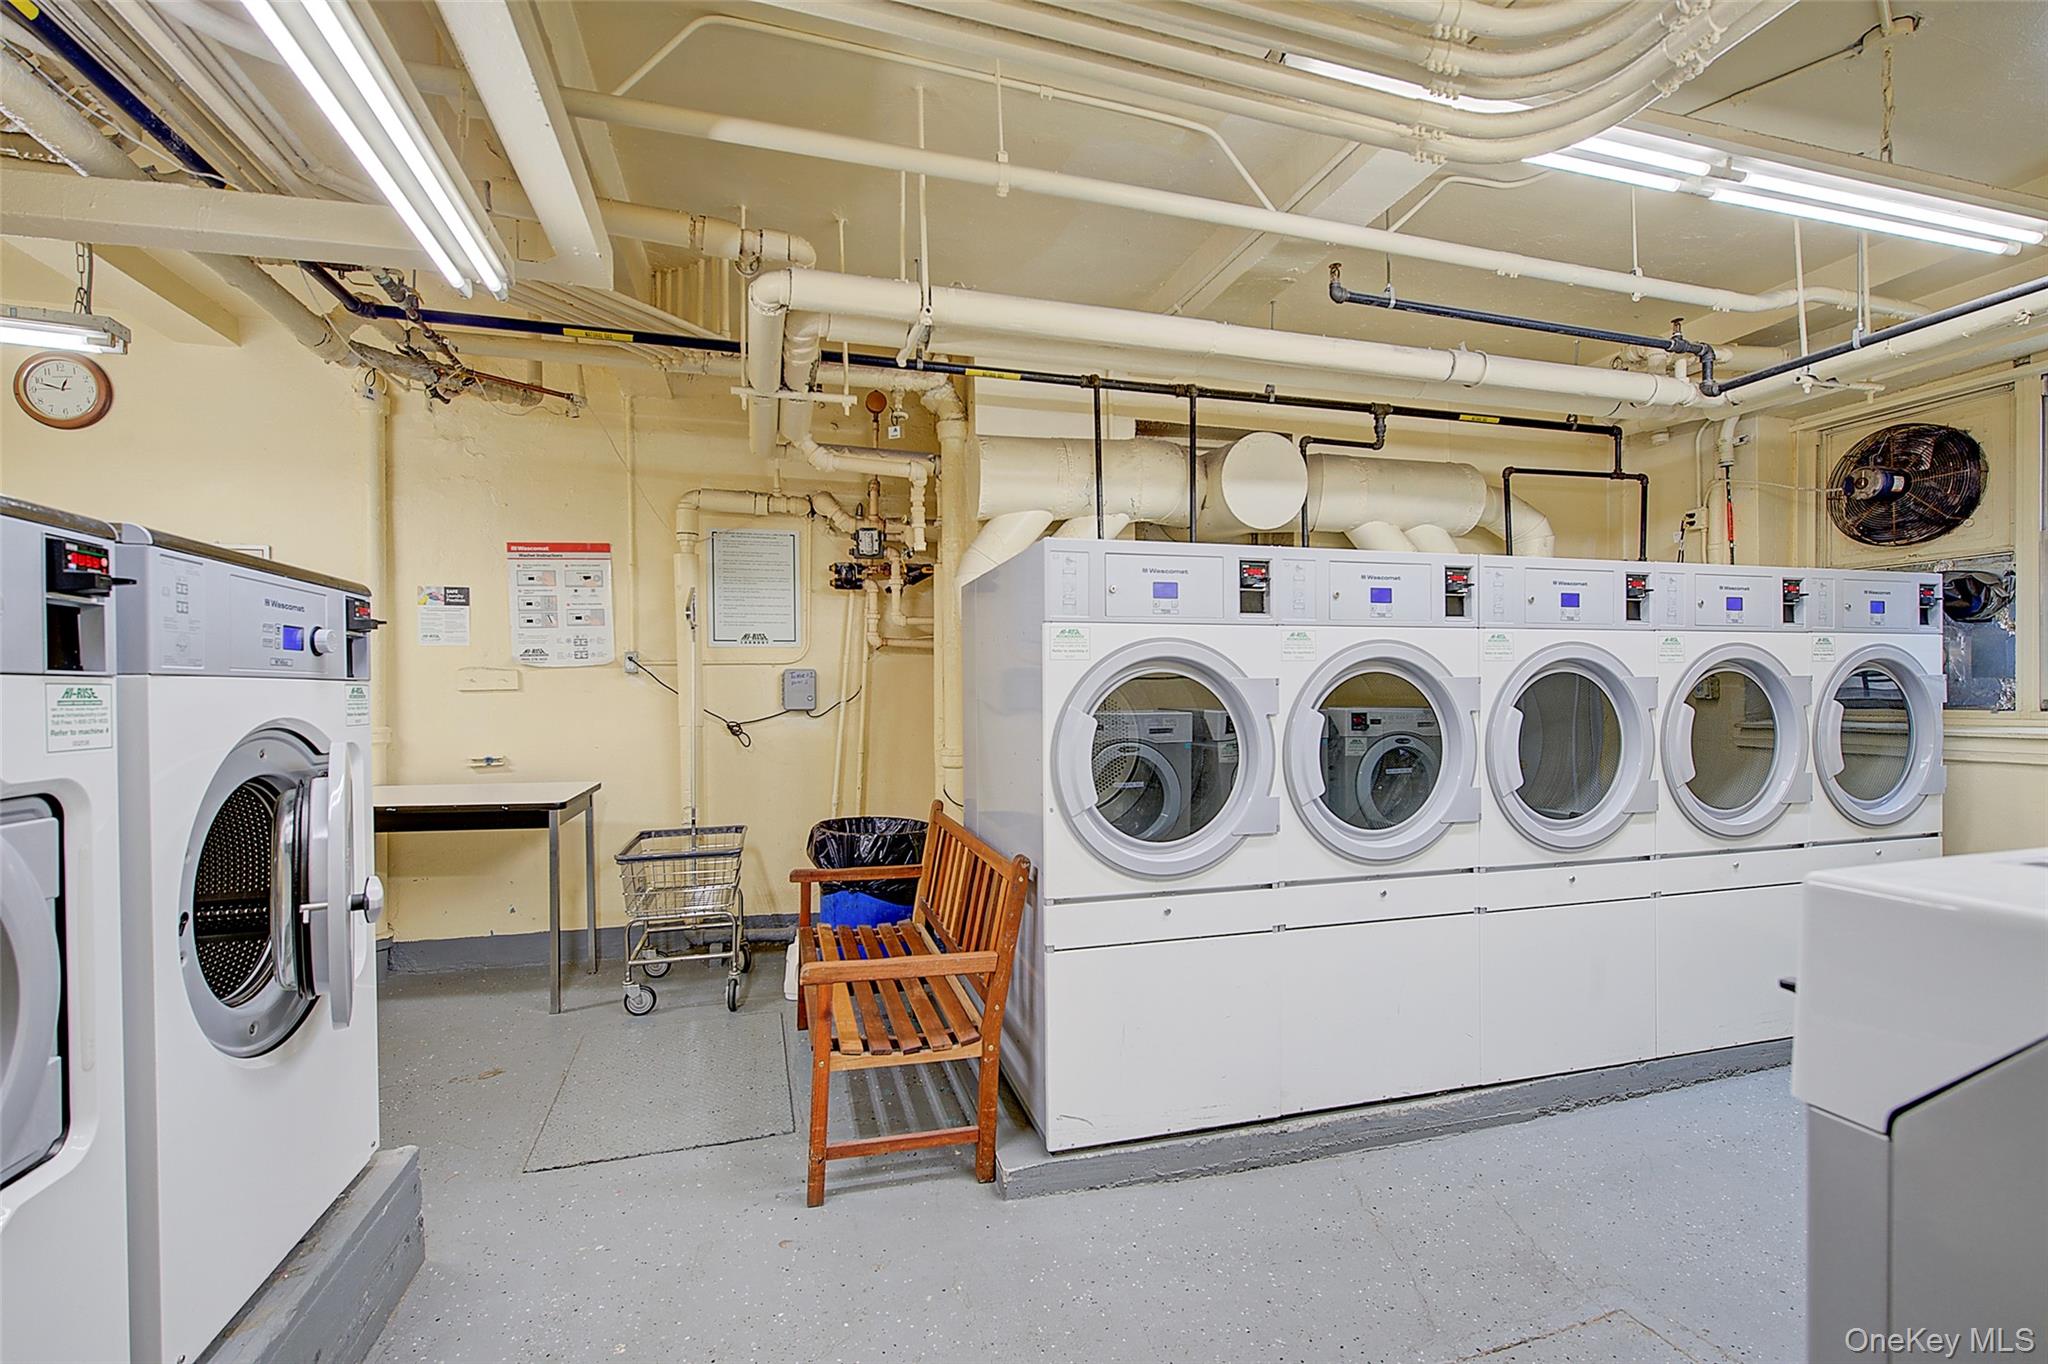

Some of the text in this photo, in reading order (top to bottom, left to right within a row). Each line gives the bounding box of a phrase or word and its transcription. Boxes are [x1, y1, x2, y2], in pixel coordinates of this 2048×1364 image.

[44, 367, 51, 376] 11
[56, 363, 65, 371] 12
[271, 600, 305, 613] Wascomat
[62, 687, 99, 699] HI-RISE
